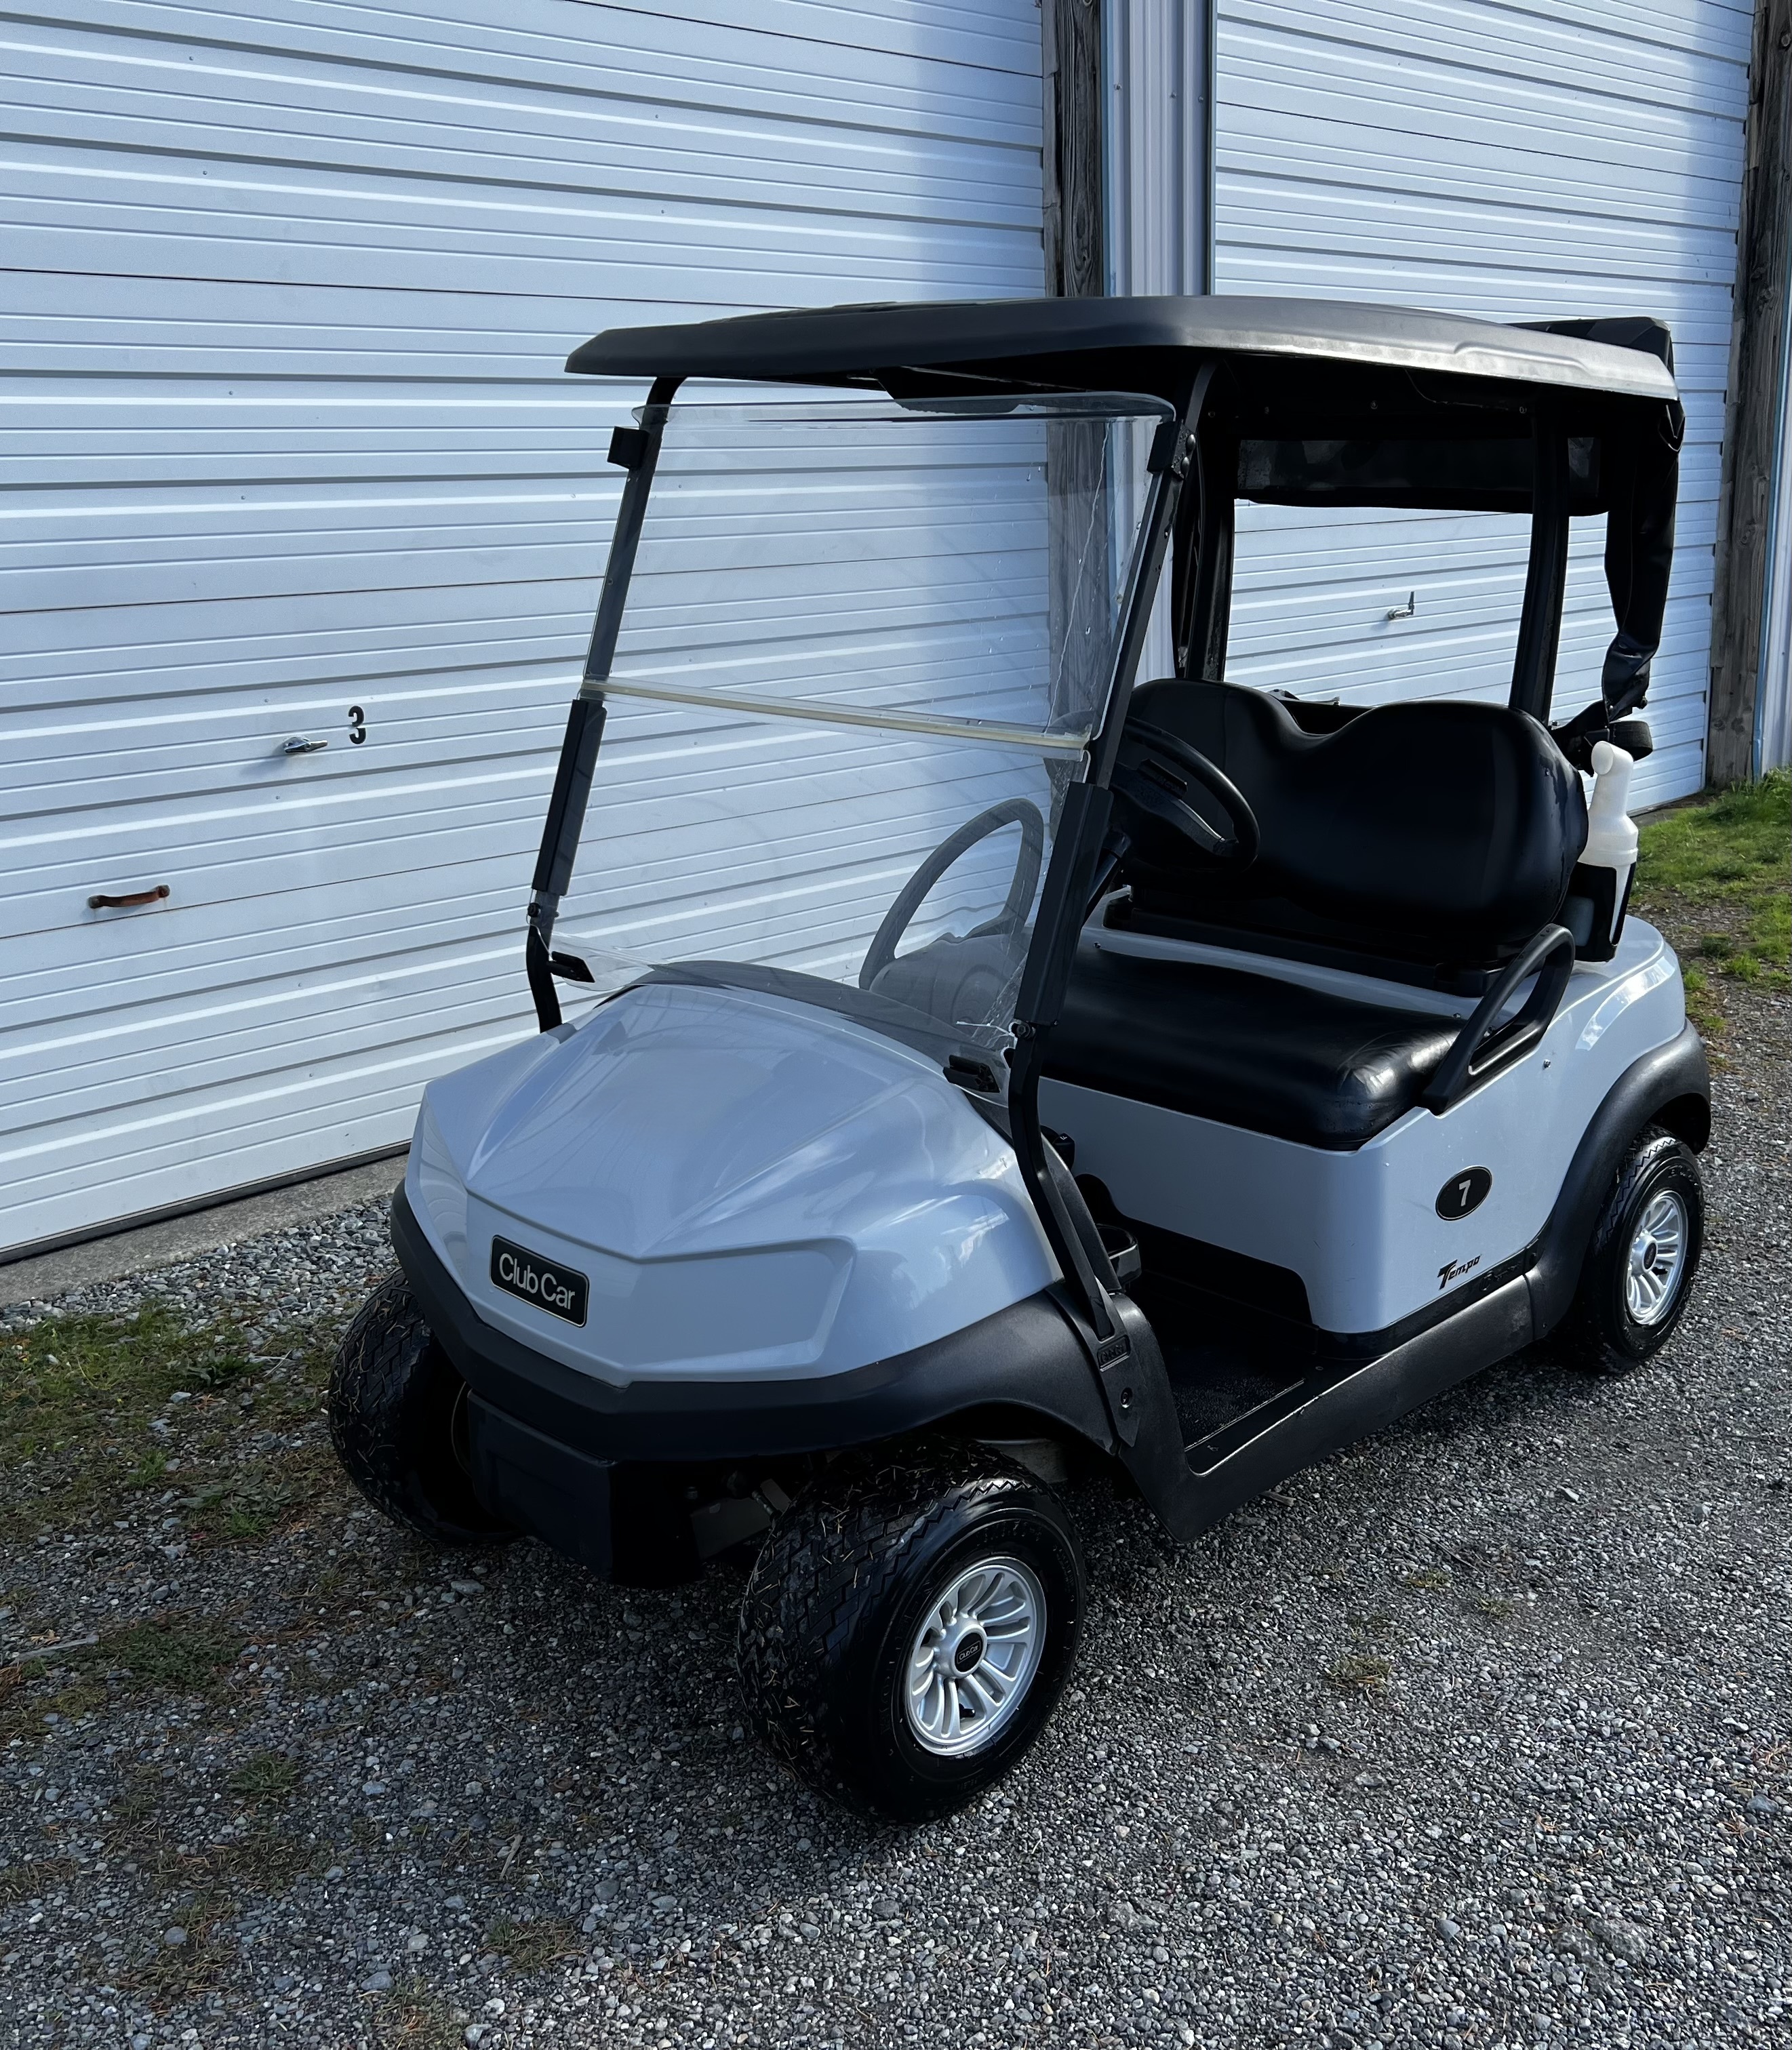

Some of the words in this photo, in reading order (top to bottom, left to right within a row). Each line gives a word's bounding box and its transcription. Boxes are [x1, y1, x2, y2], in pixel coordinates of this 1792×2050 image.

[348, 705, 366, 744] 3
[1458, 1179, 1471, 1207] 7
[499, 1253, 538, 1293] Club
[541, 1272, 576, 1310] Car
[1437, 1255, 1481, 1290] Tempo
[959, 1649, 970, 1660] Club
[970, 1645, 978, 1654] Car
